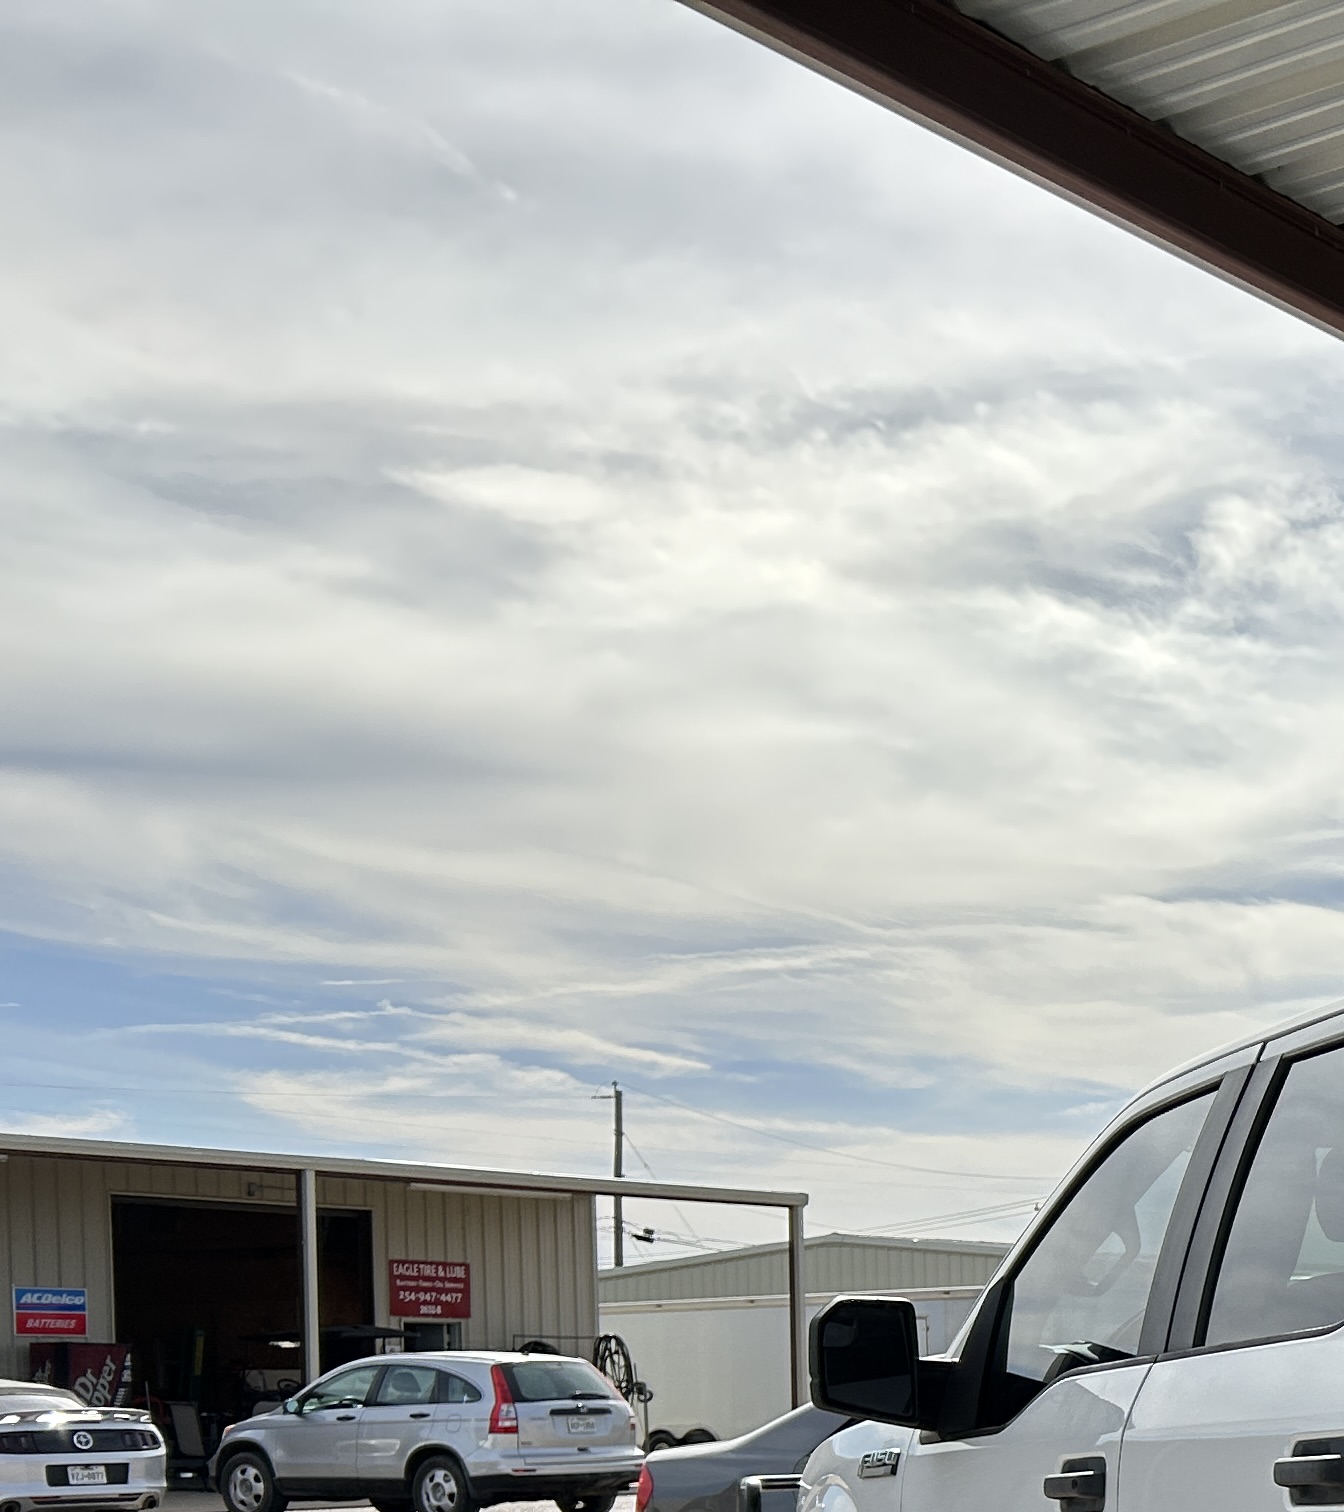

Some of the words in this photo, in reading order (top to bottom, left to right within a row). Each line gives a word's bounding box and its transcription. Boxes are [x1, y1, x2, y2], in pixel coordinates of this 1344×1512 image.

[393, 1263, 418, 1277] EAGLE
[419, 1264, 436, 1277] TIRE
[438, 1265, 445, 1278] &
[446, 1266, 466, 1279] LUBE
[20, 1292, 85, 1305] ACDelco
[399, 1290, 463, 1303] 254-947-4477
[26, 1318, 77, 1329] BATTERIES
[74, 1368, 99, 1401] Dr
[90, 1354, 117, 1407] pper
